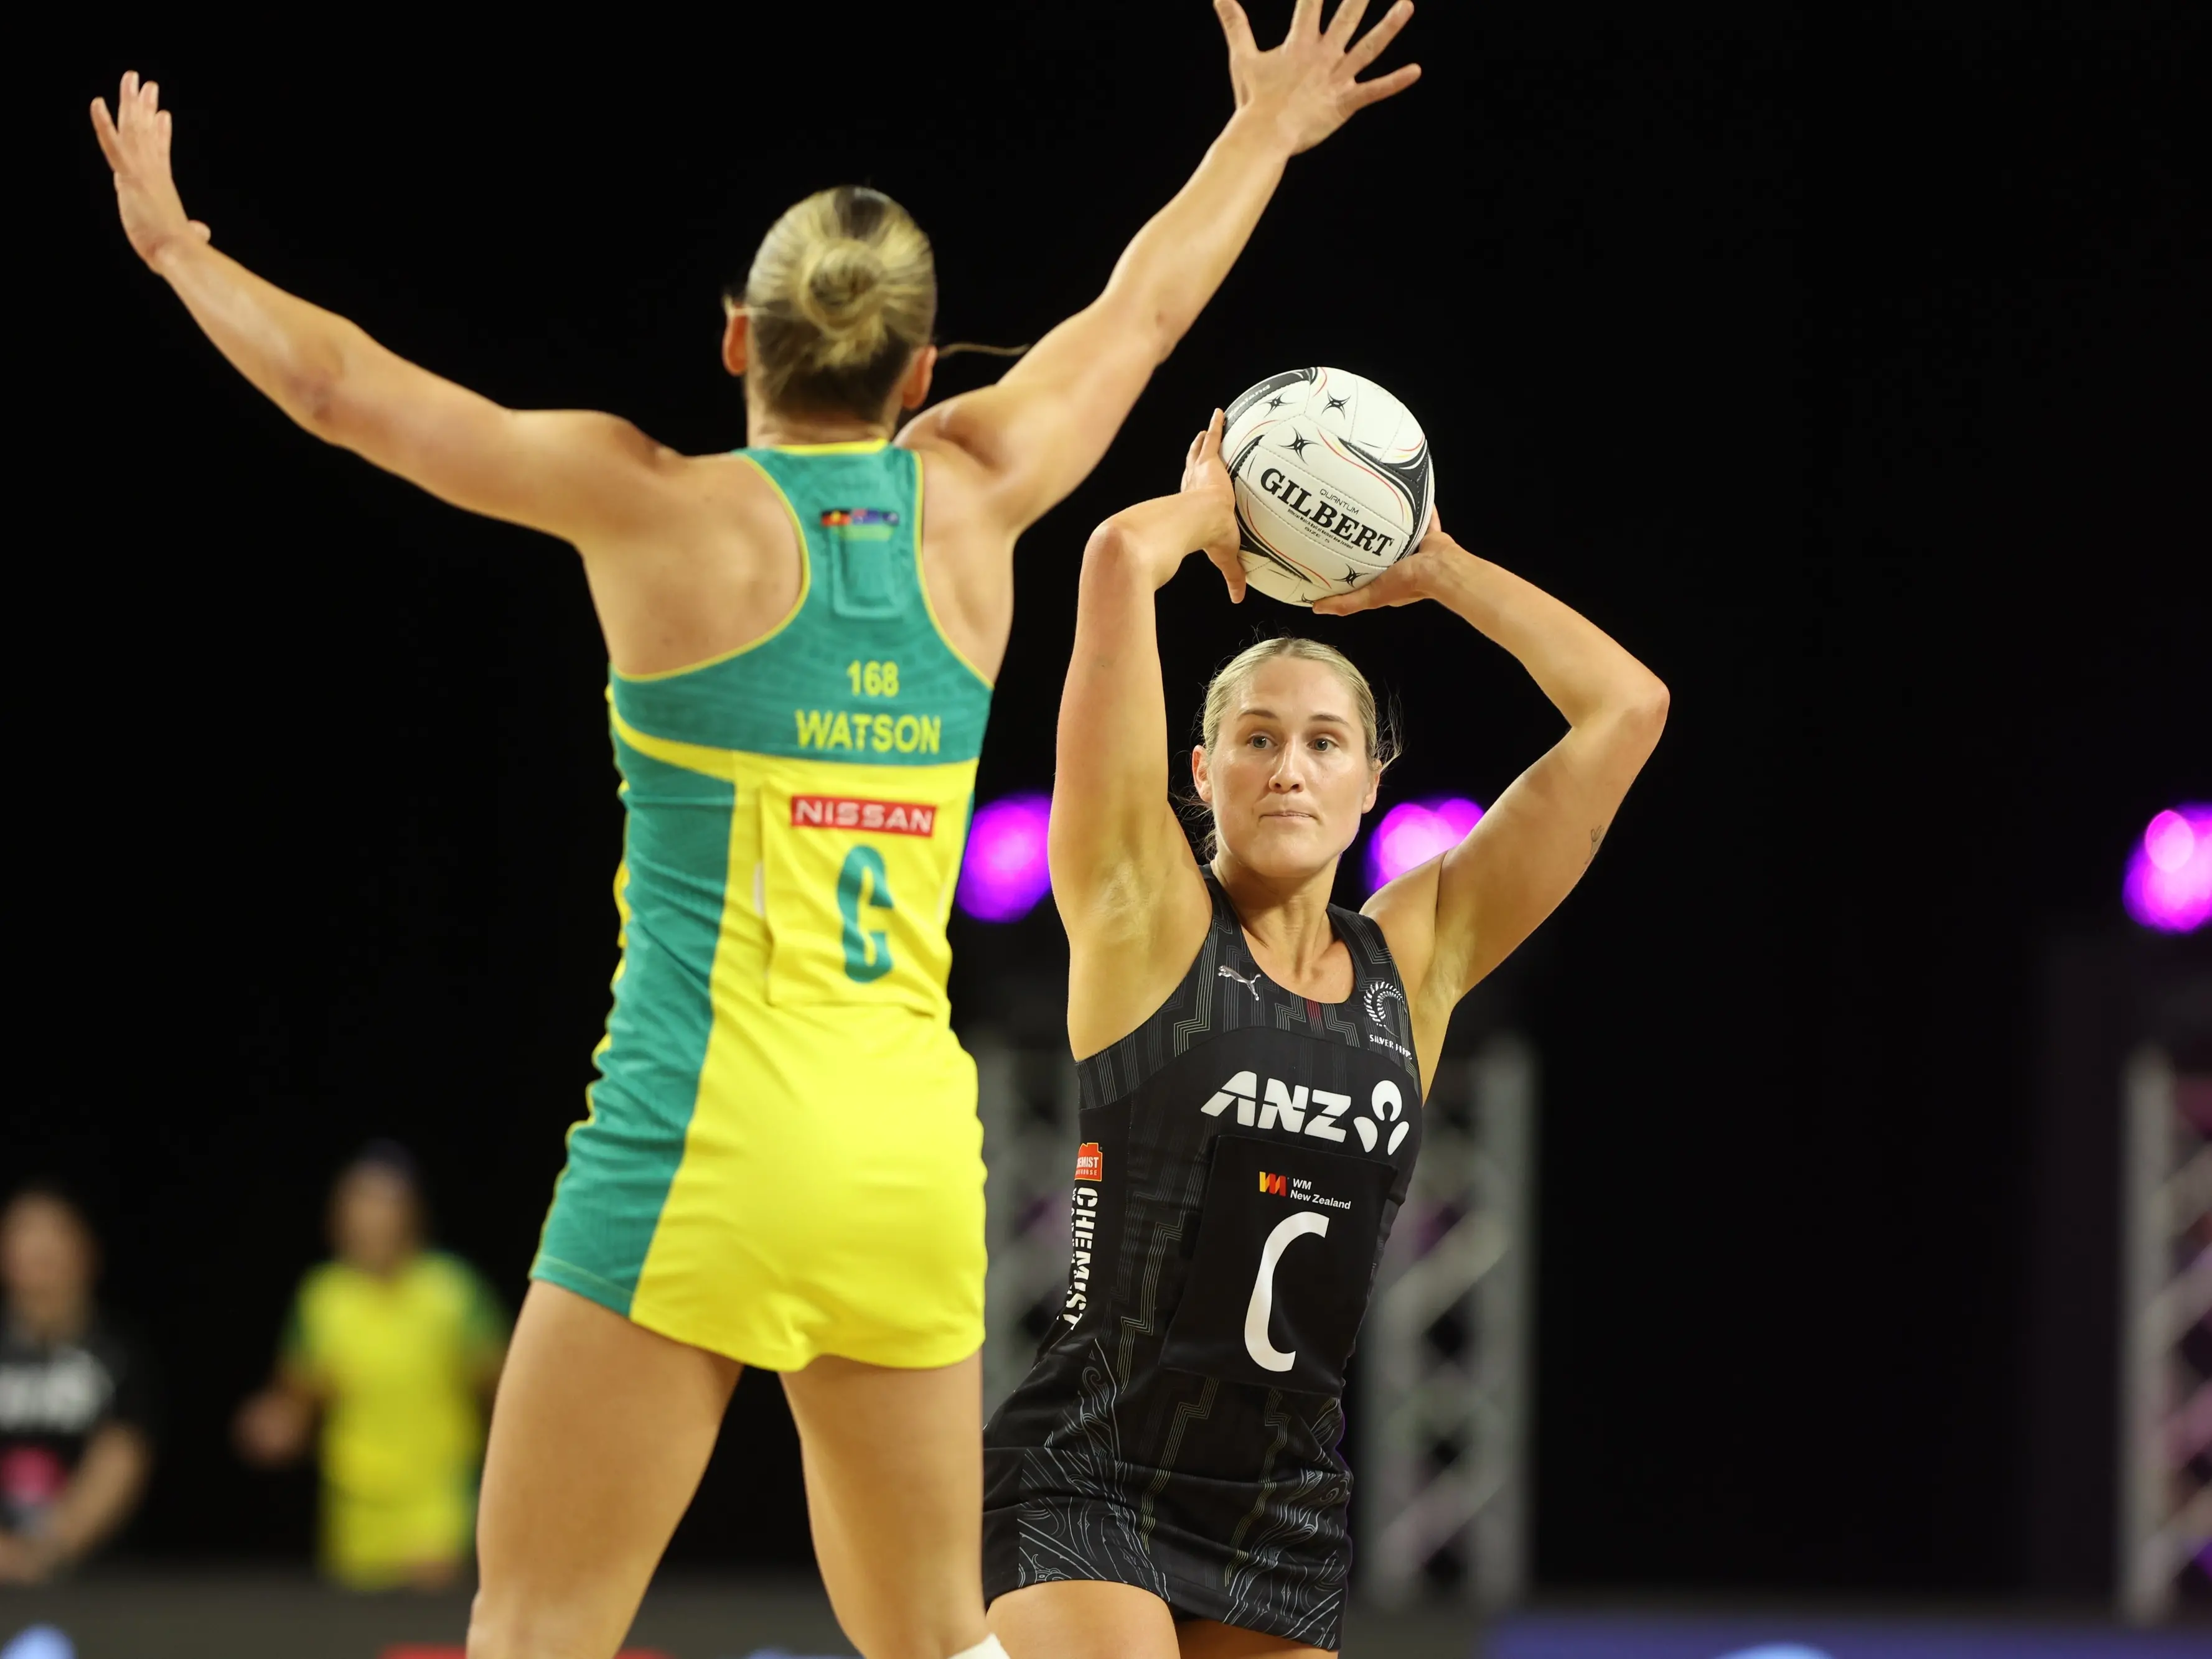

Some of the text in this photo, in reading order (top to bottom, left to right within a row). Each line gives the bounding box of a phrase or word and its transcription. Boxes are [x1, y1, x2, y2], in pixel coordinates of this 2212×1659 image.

[1260, 468, 1394, 556] GILBERT
[1287, 508, 1300, 519] Official
[1319, 488, 1359, 515] QUANTUM
[846, 660, 899, 697] 168
[795, 709, 941, 755] WATSON
[794, 798, 934, 834] NISSAN
[837, 844, 894, 984] C
[1369, 1034, 1394, 1050] SILVER
[1200, 1070, 1352, 1143] ANZ
[1290, 1189, 1352, 1210] New Zealand
[1293, 1178, 1312, 1190] WM
[1062, 1187, 1099, 1330] CHEMIST
[1244, 1211, 1330, 1372] C
